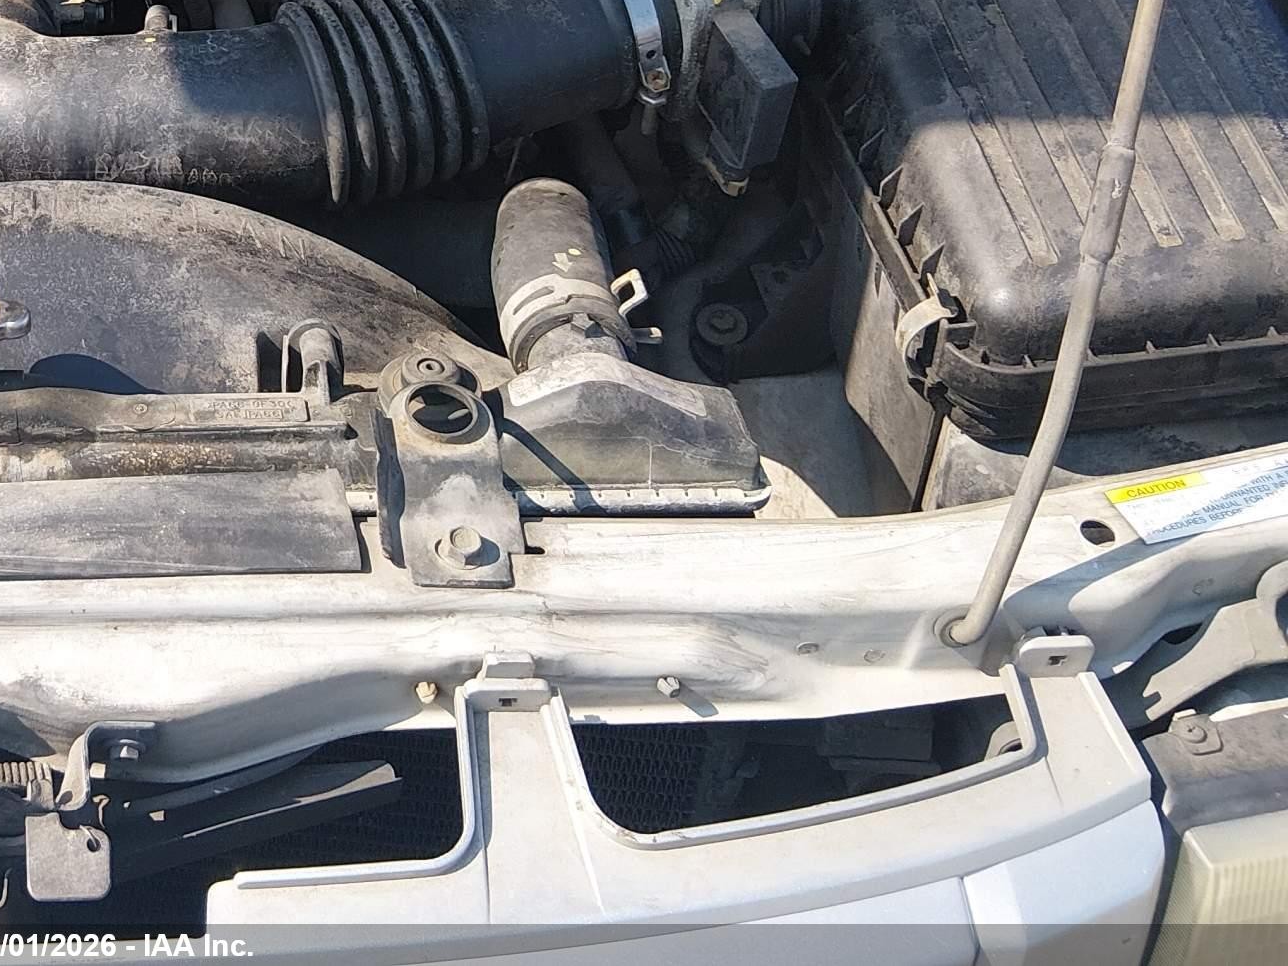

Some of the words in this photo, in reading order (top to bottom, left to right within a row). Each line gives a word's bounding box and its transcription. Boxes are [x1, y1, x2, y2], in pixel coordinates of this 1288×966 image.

[1126, 479, 1187, 499] CAUTION
[1201, 499, 1241, 515] MANUAL
[1244, 494, 1263, 506] FOR
